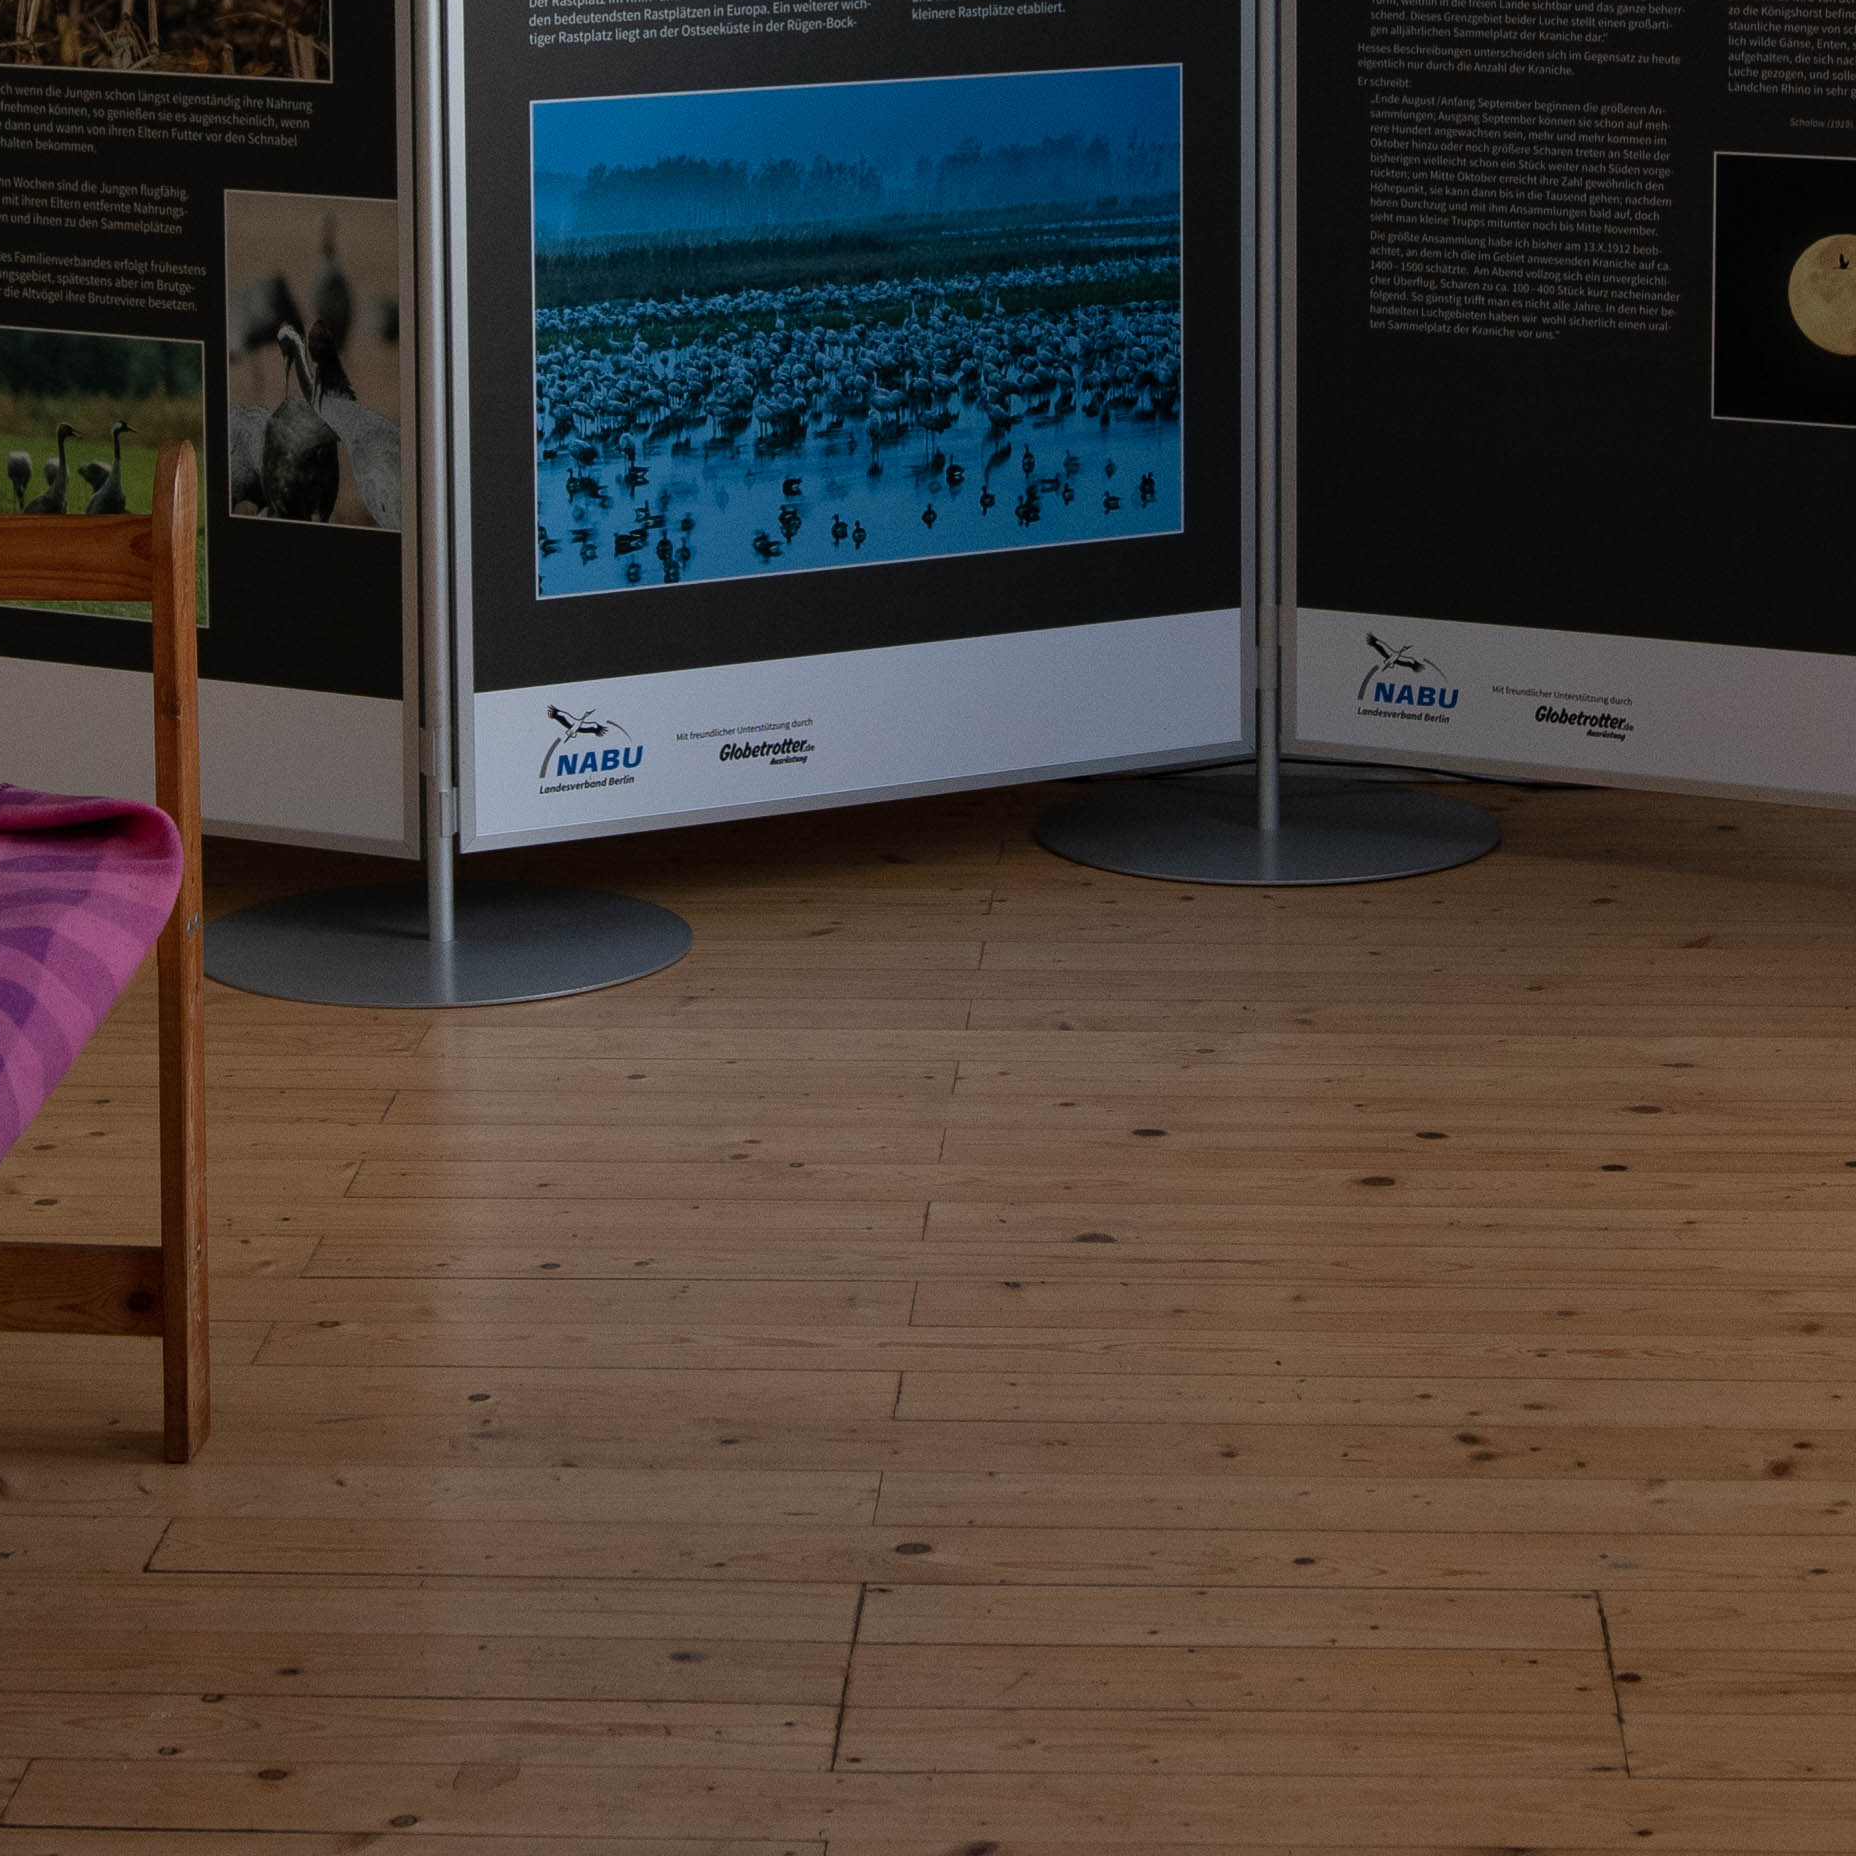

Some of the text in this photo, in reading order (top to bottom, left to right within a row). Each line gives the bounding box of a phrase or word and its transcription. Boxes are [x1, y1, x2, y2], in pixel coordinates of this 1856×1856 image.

[1374, 682, 1459, 709] NABU
[1492, 685, 1632, 706] Mit freundlicher Unterstützung durch
[1357, 706, 1450, 724] Landesverband Berlin
[1535, 705, 1634, 732] Globetrotter.de
[676, 718, 813, 742] Mit freundlicher Unterstützung durch
[556, 745, 644, 777] NABU
[719, 737, 815, 762] Globetrotter.de
[539, 774, 635, 795] Landesverband Berlin
